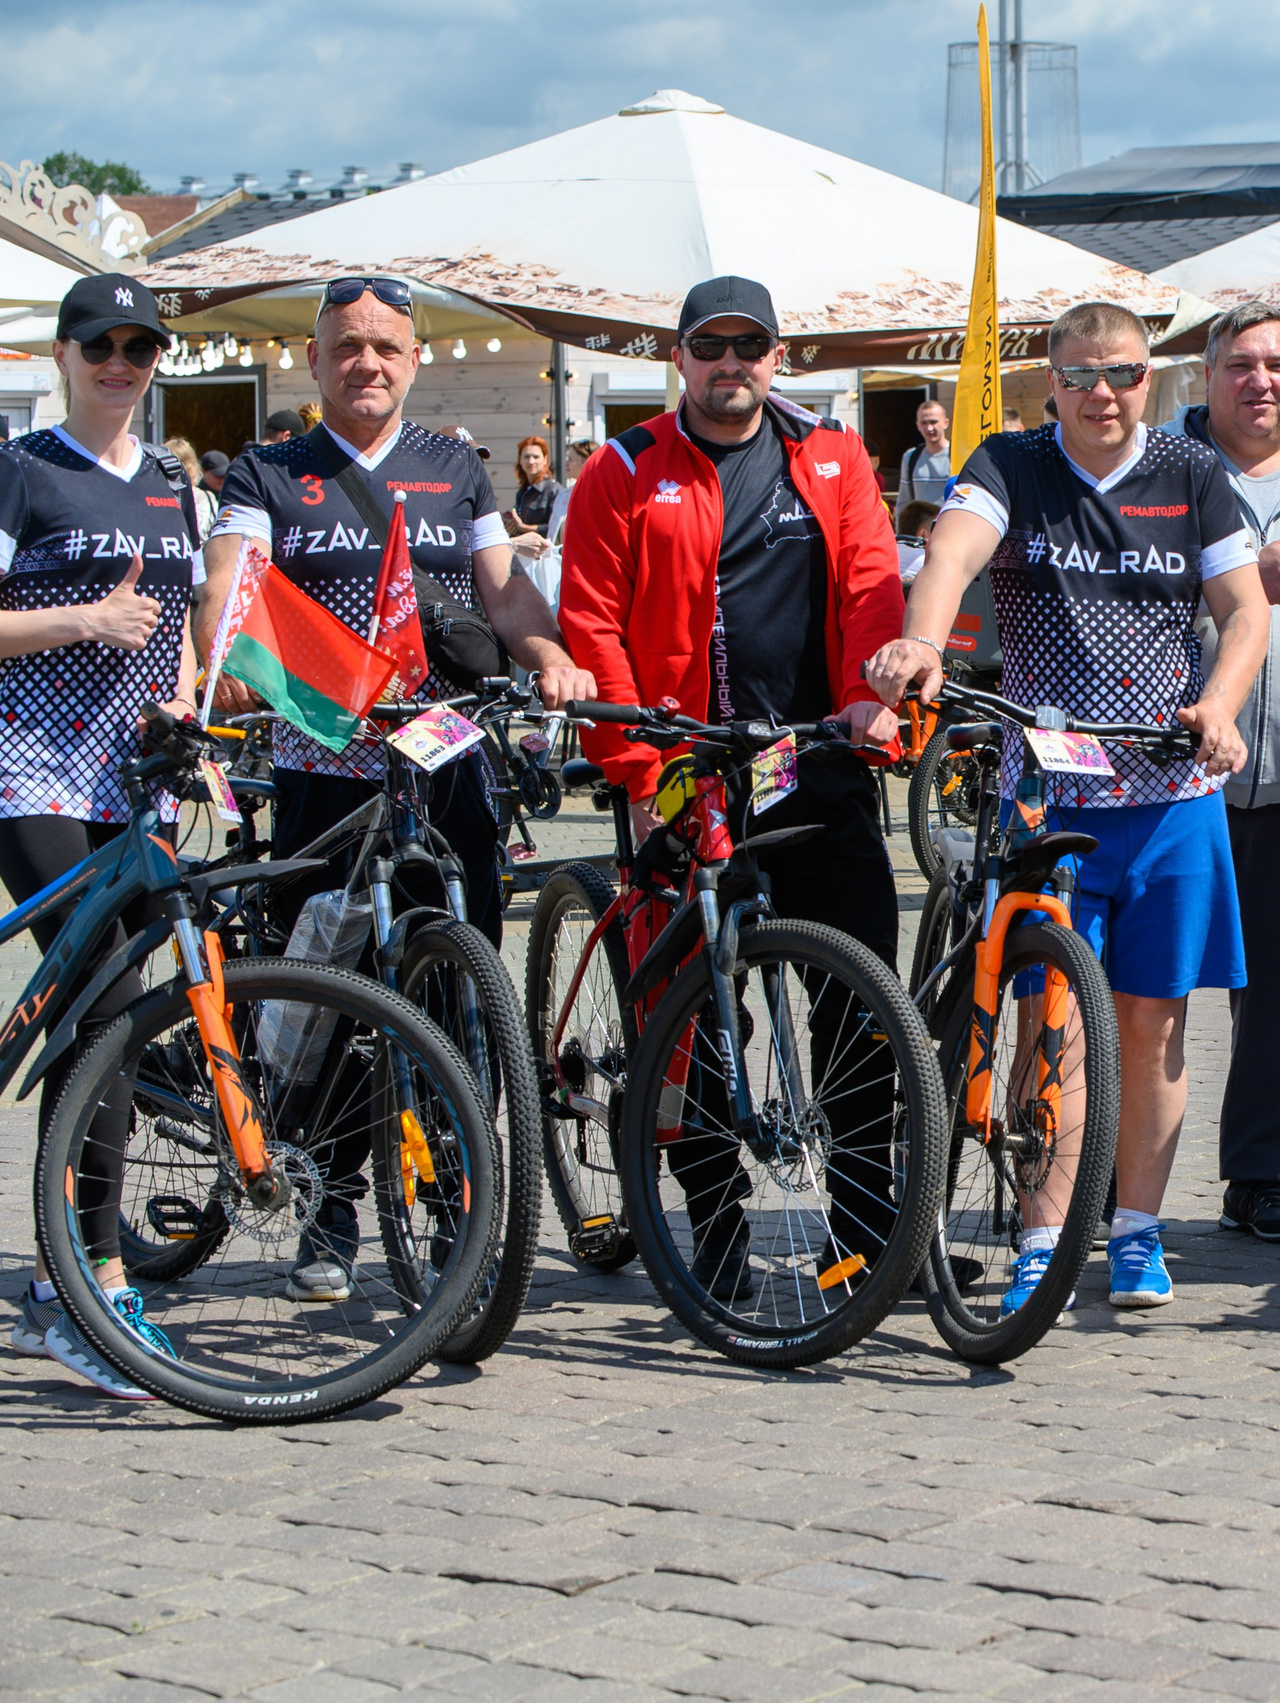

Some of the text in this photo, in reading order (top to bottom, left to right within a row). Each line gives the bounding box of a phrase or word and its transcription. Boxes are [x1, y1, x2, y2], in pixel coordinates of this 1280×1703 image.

[300, 474, 325, 505] 3
[386, 481, 452, 494] РЕМАВТОДОР
[1119, 505, 1189, 518] РЕМАВТОДОР
[1026, 532, 1186, 575] #ZAV_RAD
[420, 744, 446, 763] 11863
[1042, 756, 1071, 765] 11864
[244, 1389, 319, 1406] KENDA
